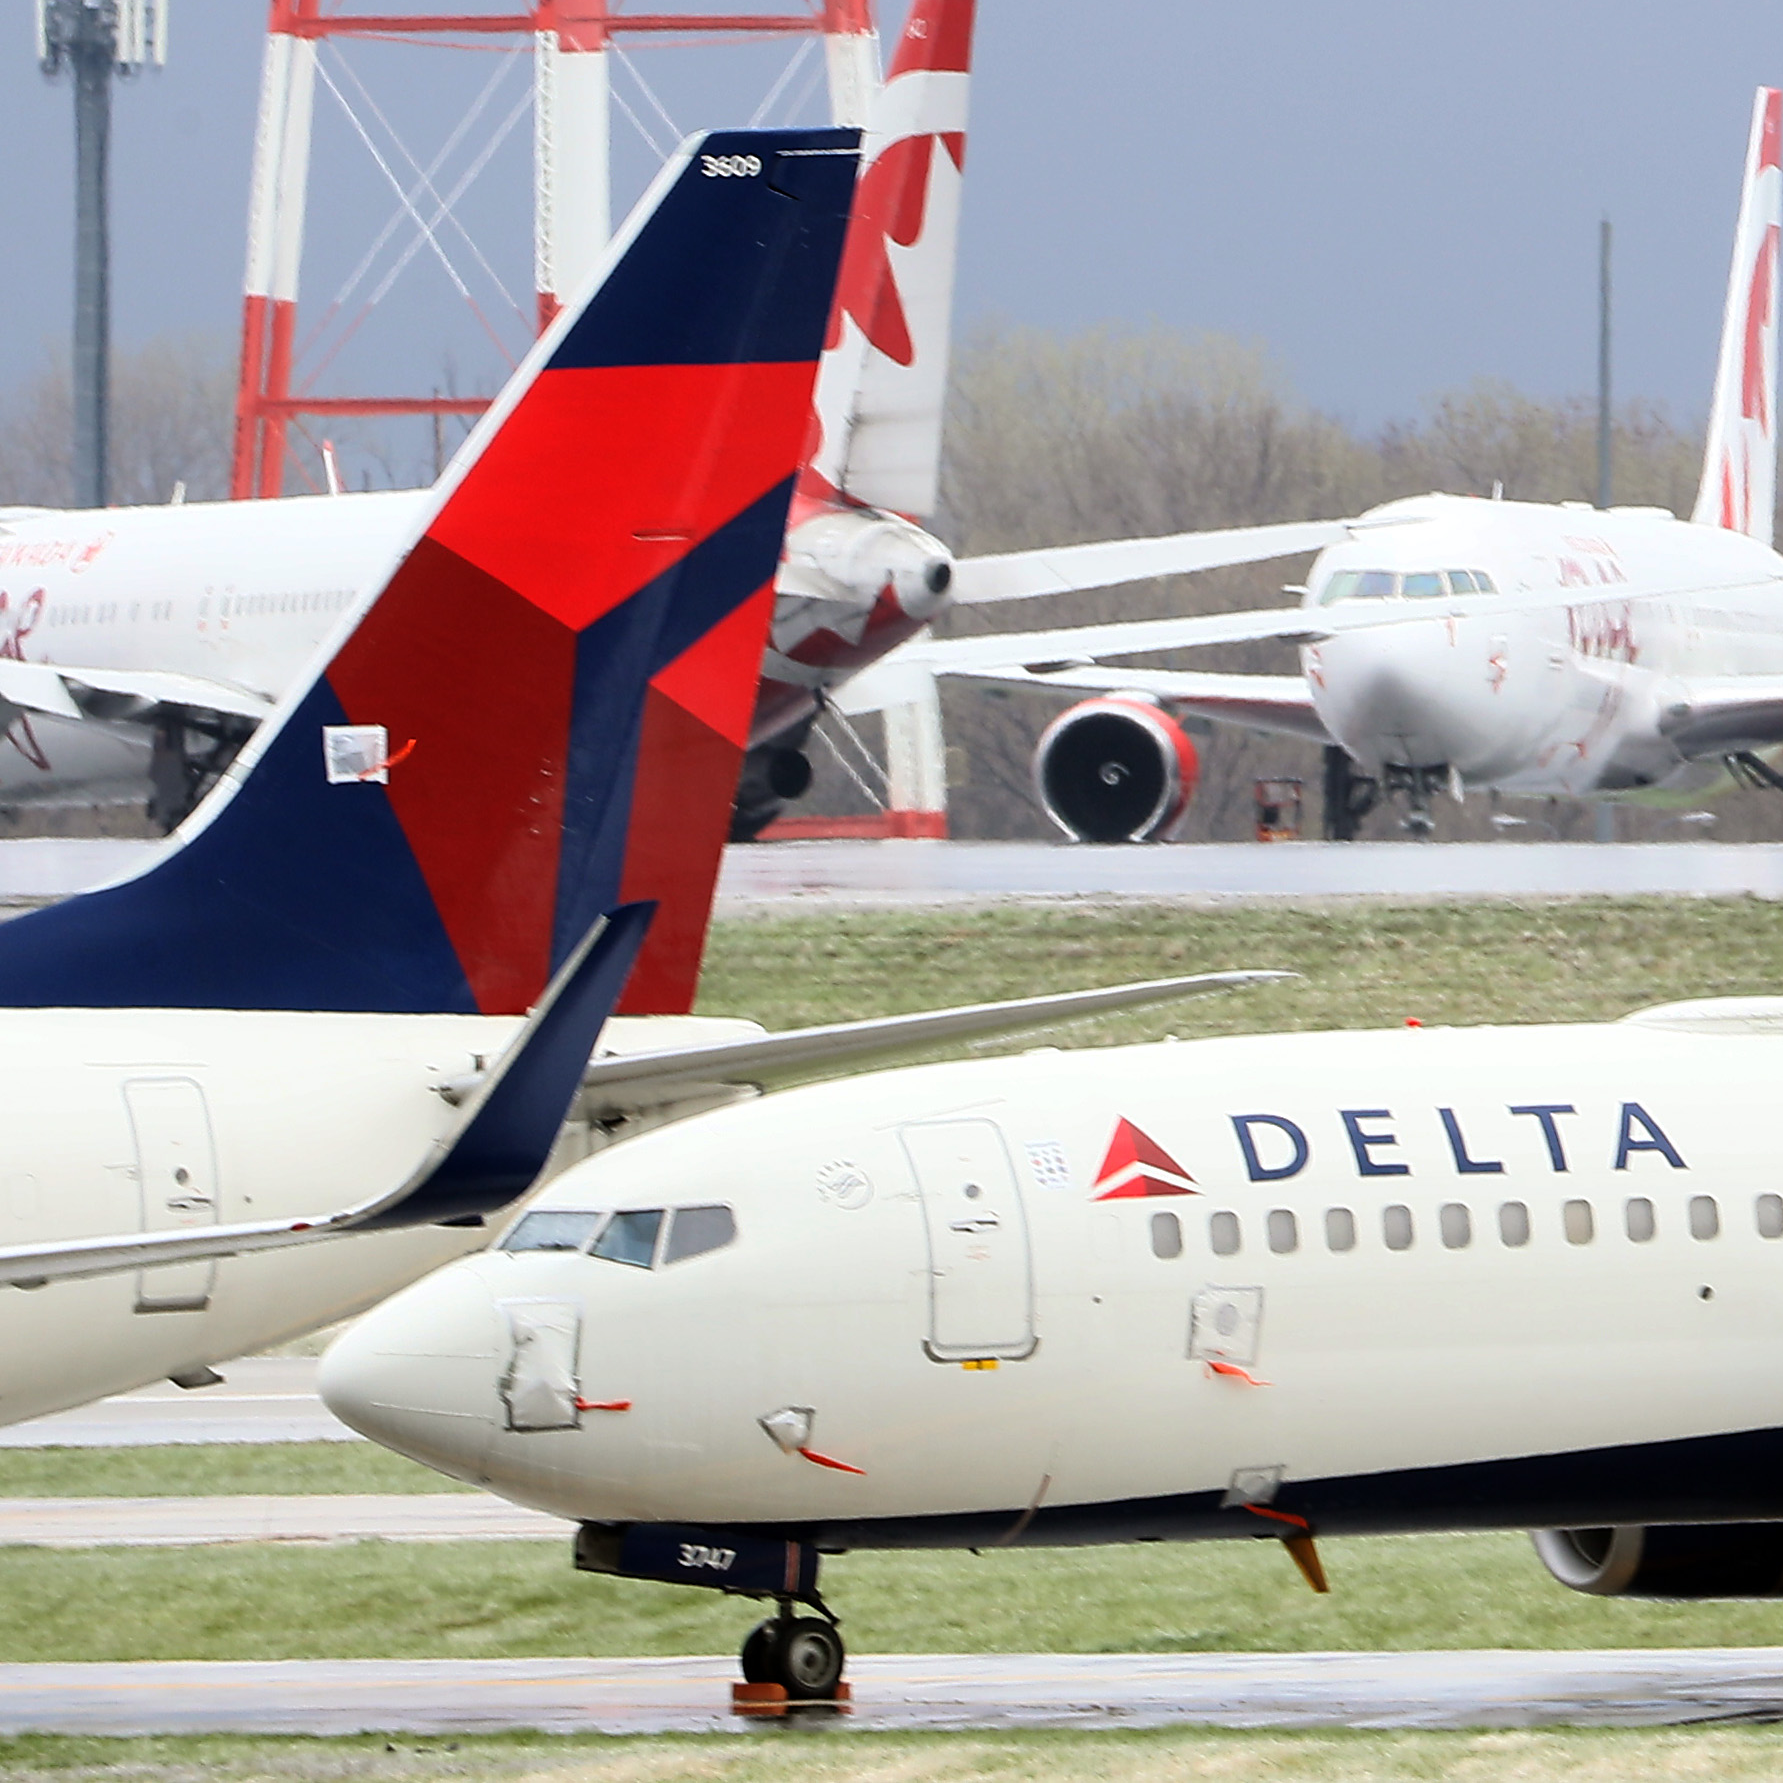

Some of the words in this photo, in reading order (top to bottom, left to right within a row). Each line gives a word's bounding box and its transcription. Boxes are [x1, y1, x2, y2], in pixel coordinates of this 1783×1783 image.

[700, 154, 762, 178] 3609
[1230, 1102, 1690, 1183] DELTA
[677, 1543, 738, 1571] 3747
